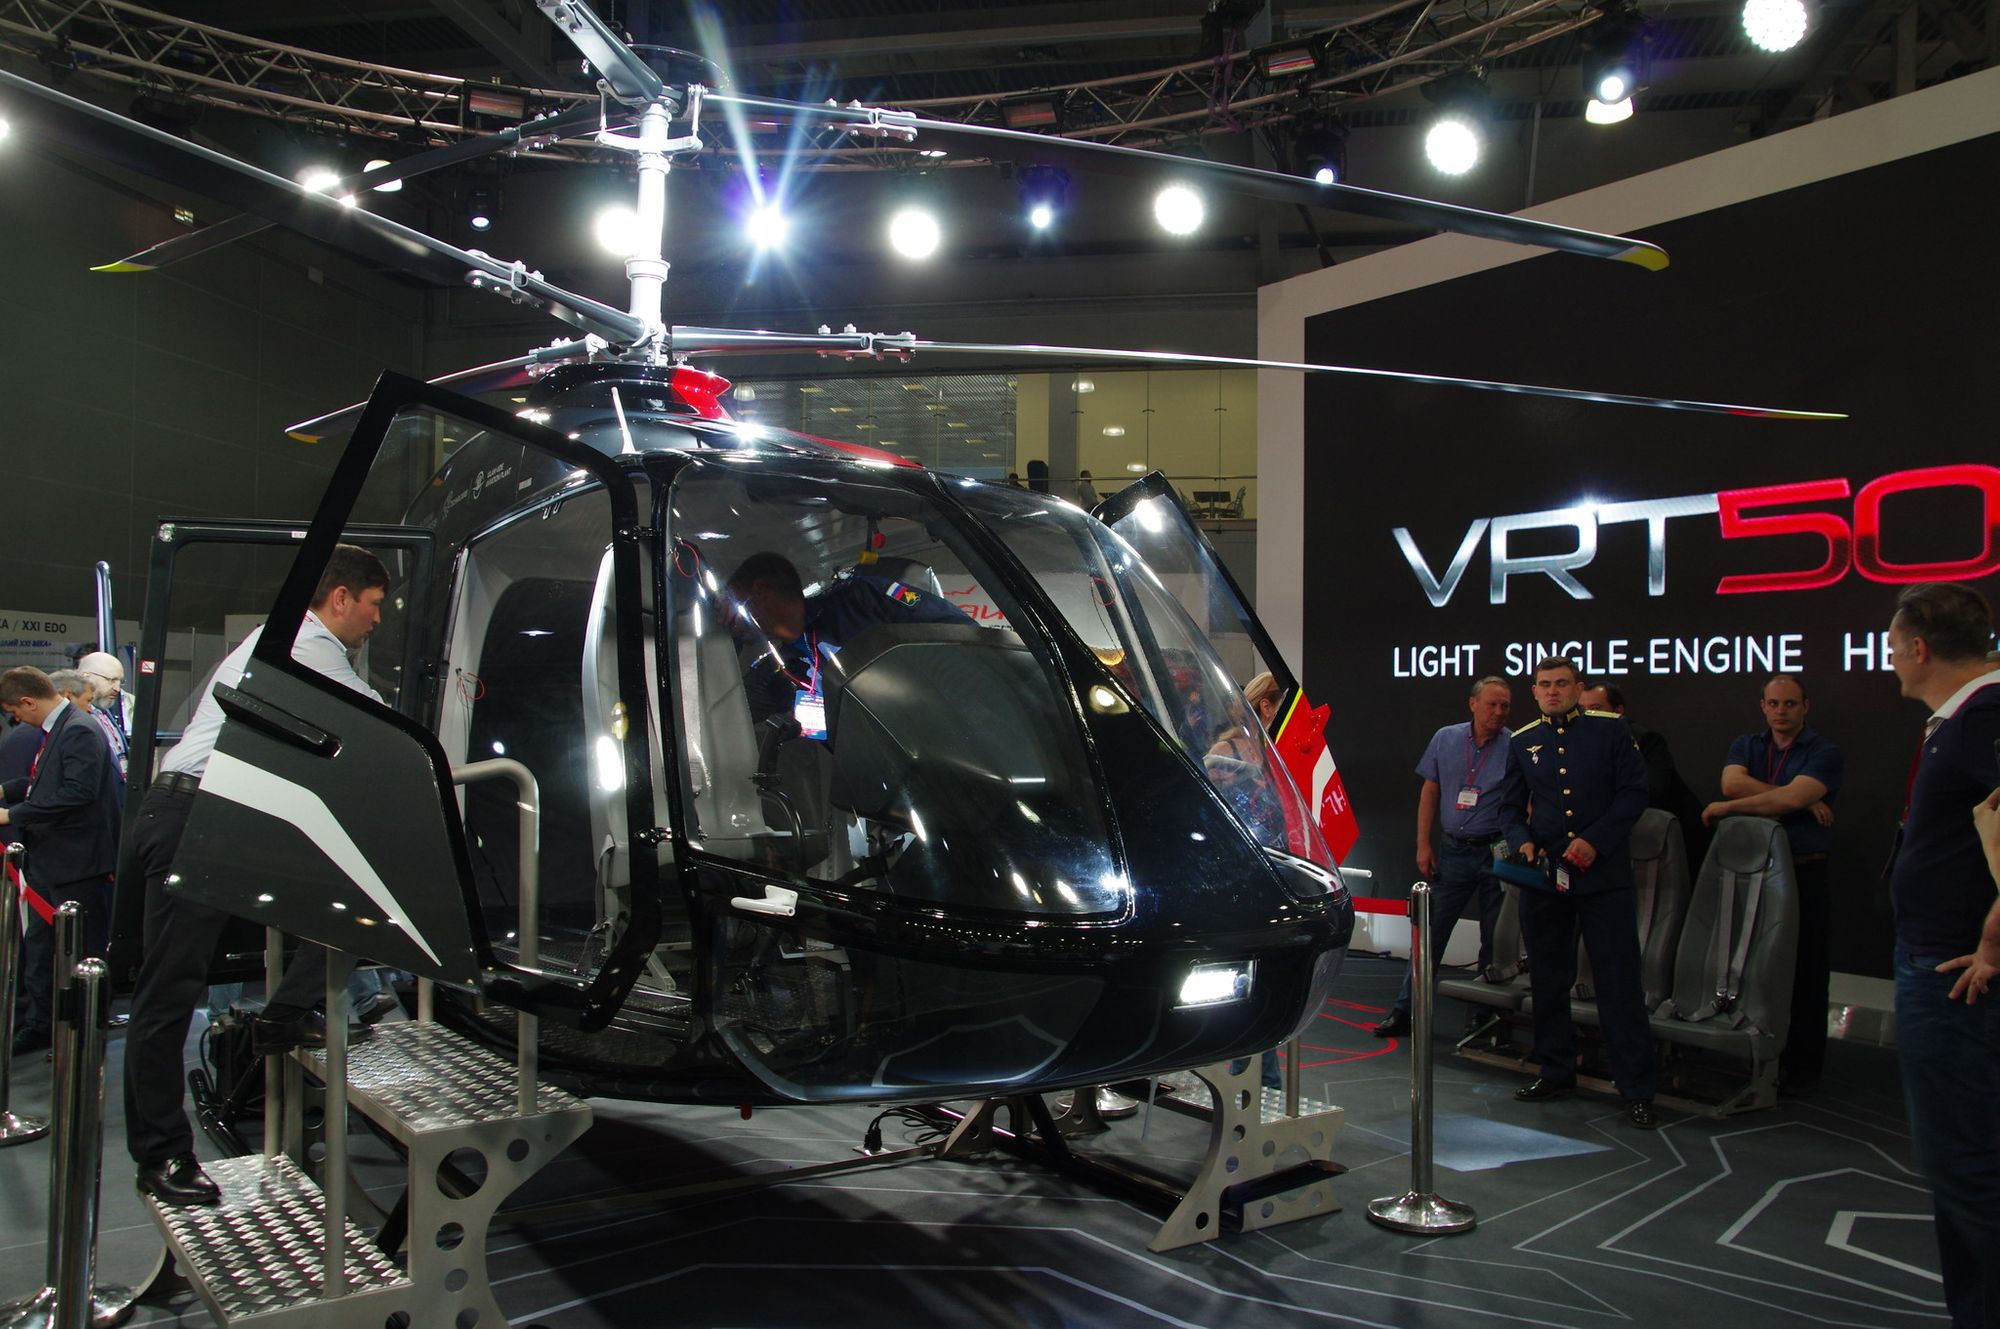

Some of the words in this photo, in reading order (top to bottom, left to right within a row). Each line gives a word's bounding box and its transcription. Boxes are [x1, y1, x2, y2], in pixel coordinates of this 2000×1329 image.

[22, 620, 41, 631] XXI
[44, 622, 67, 634] EDO
[1393, 644, 1480, 677] LIGHT
[1504, 634, 1804, 676] SINGLE-ENGINE
